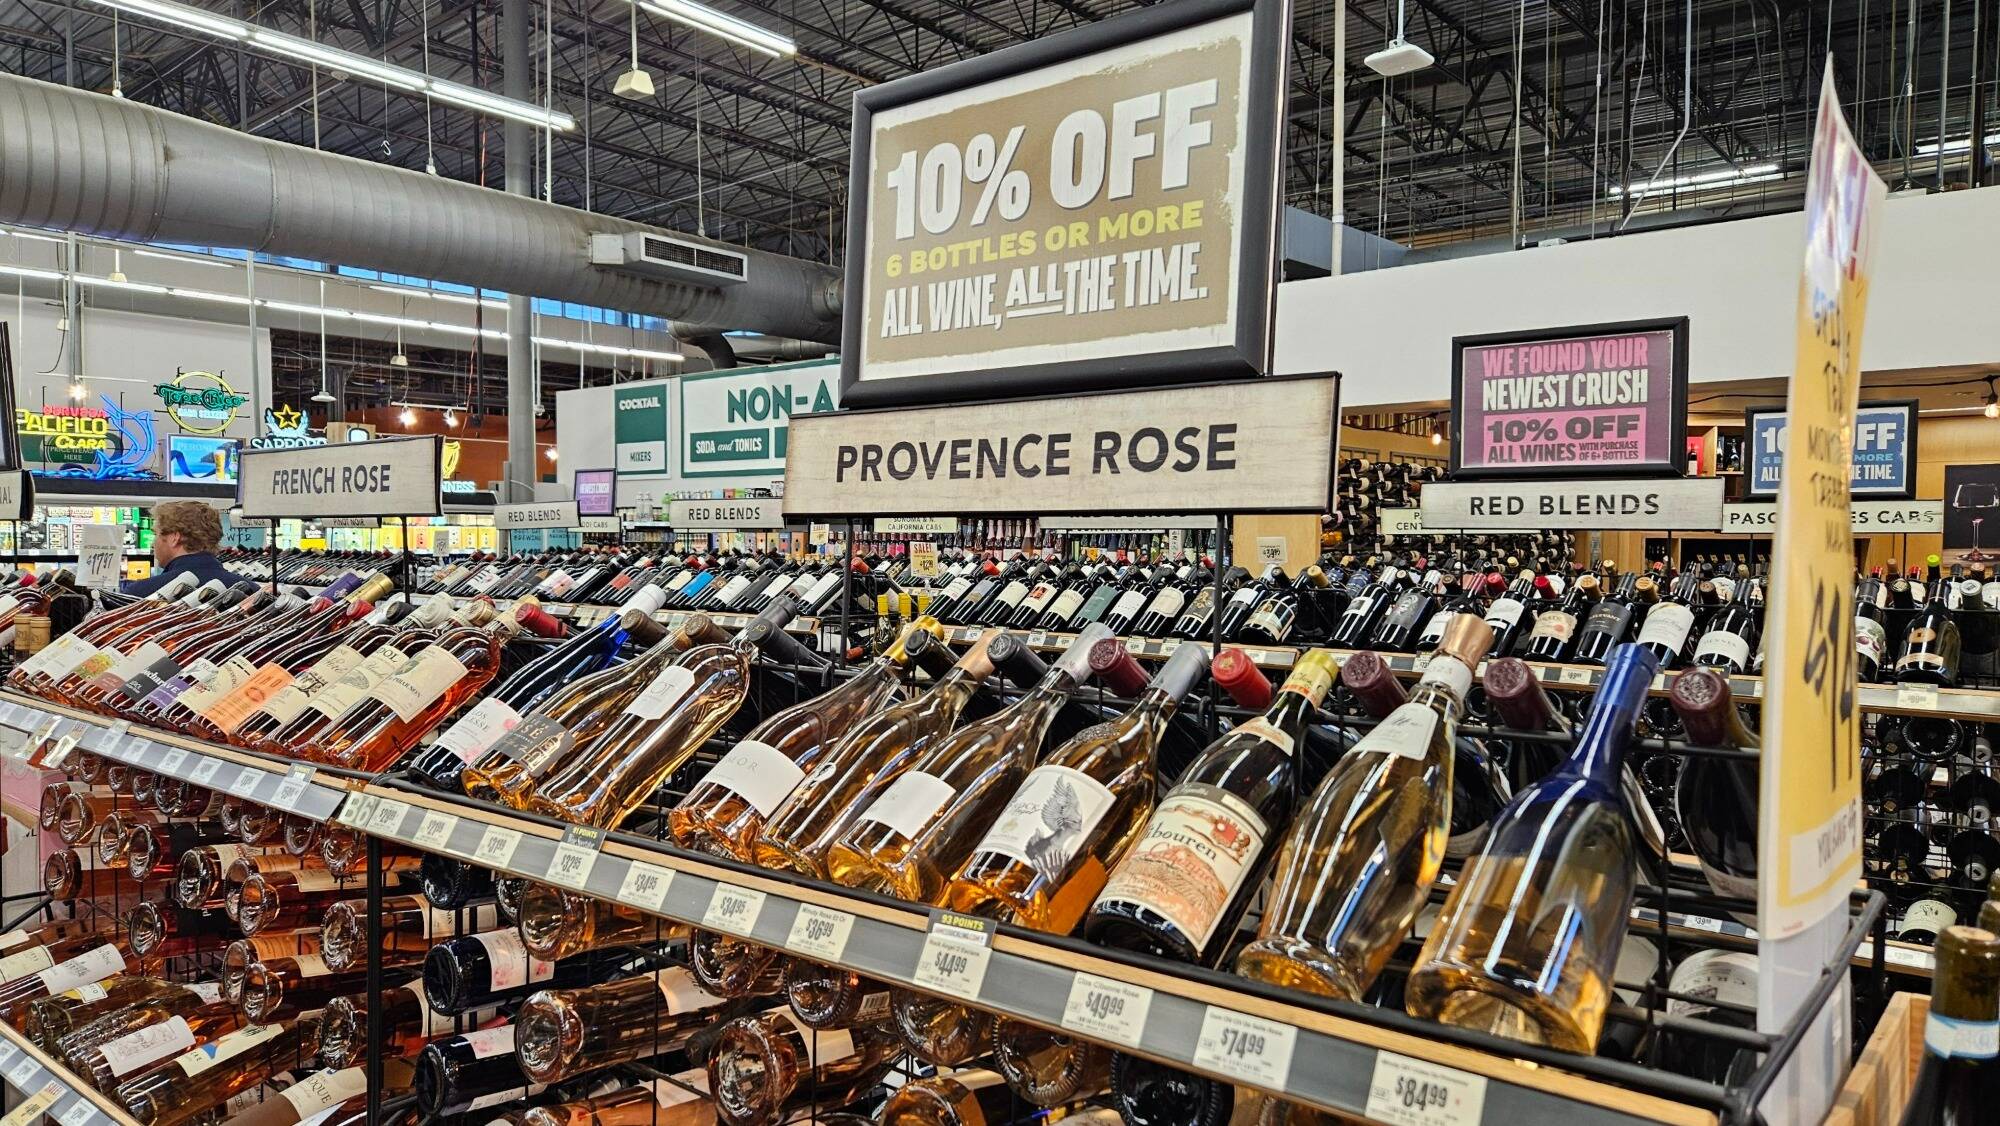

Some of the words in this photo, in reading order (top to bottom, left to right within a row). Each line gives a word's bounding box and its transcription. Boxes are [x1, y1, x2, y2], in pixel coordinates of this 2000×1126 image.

[887, 125, 1031, 240] 10%
[1049, 79, 1218, 210] OFF
[886, 254, 903, 278] 6
[909, 230, 1037, 275] BOTTLES
[1045, 221, 1091, 253] OR
[1099, 201, 1204, 243] MORE
[881, 287, 922, 339] ALL
[928, 273, 1002, 331] WINE,
[1006, 261, 1065, 309] ALL
[1064, 252, 1117, 316] THE
[1122, 241, 1209, 308] TIME.
[1482, 348, 1515, 377] WE
[1518, 342, 1586, 375] FOUND
[1590, 337, 1648, 369] YOUR
[727, 379, 836, 424] NON-A
[1482, 374, 1570, 411] NEWEST
[1572, 369, 1649, 406] CRUSH
[619, 397, 661, 411] COCKTAIL
[1487, 418, 1559, 443] 10%
[1565, 414, 1640, 440] OFF
[630, 450, 652, 462] MIXERS
[695, 440, 716, 455] SODA
[734, 437, 762, 453] TONICS
[835, 433, 1072, 484] PROVENCE
[1091, 423, 1238, 476] ROSE
[1488, 445, 1516, 463] ALL
[1519, 443, 1578, 463] WINES
[1579, 442, 1600, 451] WITH
[1600, 440, 1638, 451] PURCHASE
[1579, 452, 1590, 460] OF
[1603, 450, 1639, 461] BOTTLES
[272, 466, 335, 495] FRENCH
[342, 465, 391, 493] ROSE
[508, 511, 525, 522] RED
[528, 508, 561, 522] BLENDS
[688, 508, 711, 520] RED
[714, 506, 761, 520] BLENDS
[1470, 495, 1531, 516] RED
[1538, 492, 1660, 516] BLENDS
[953, 916, 985, 931] POINTS
